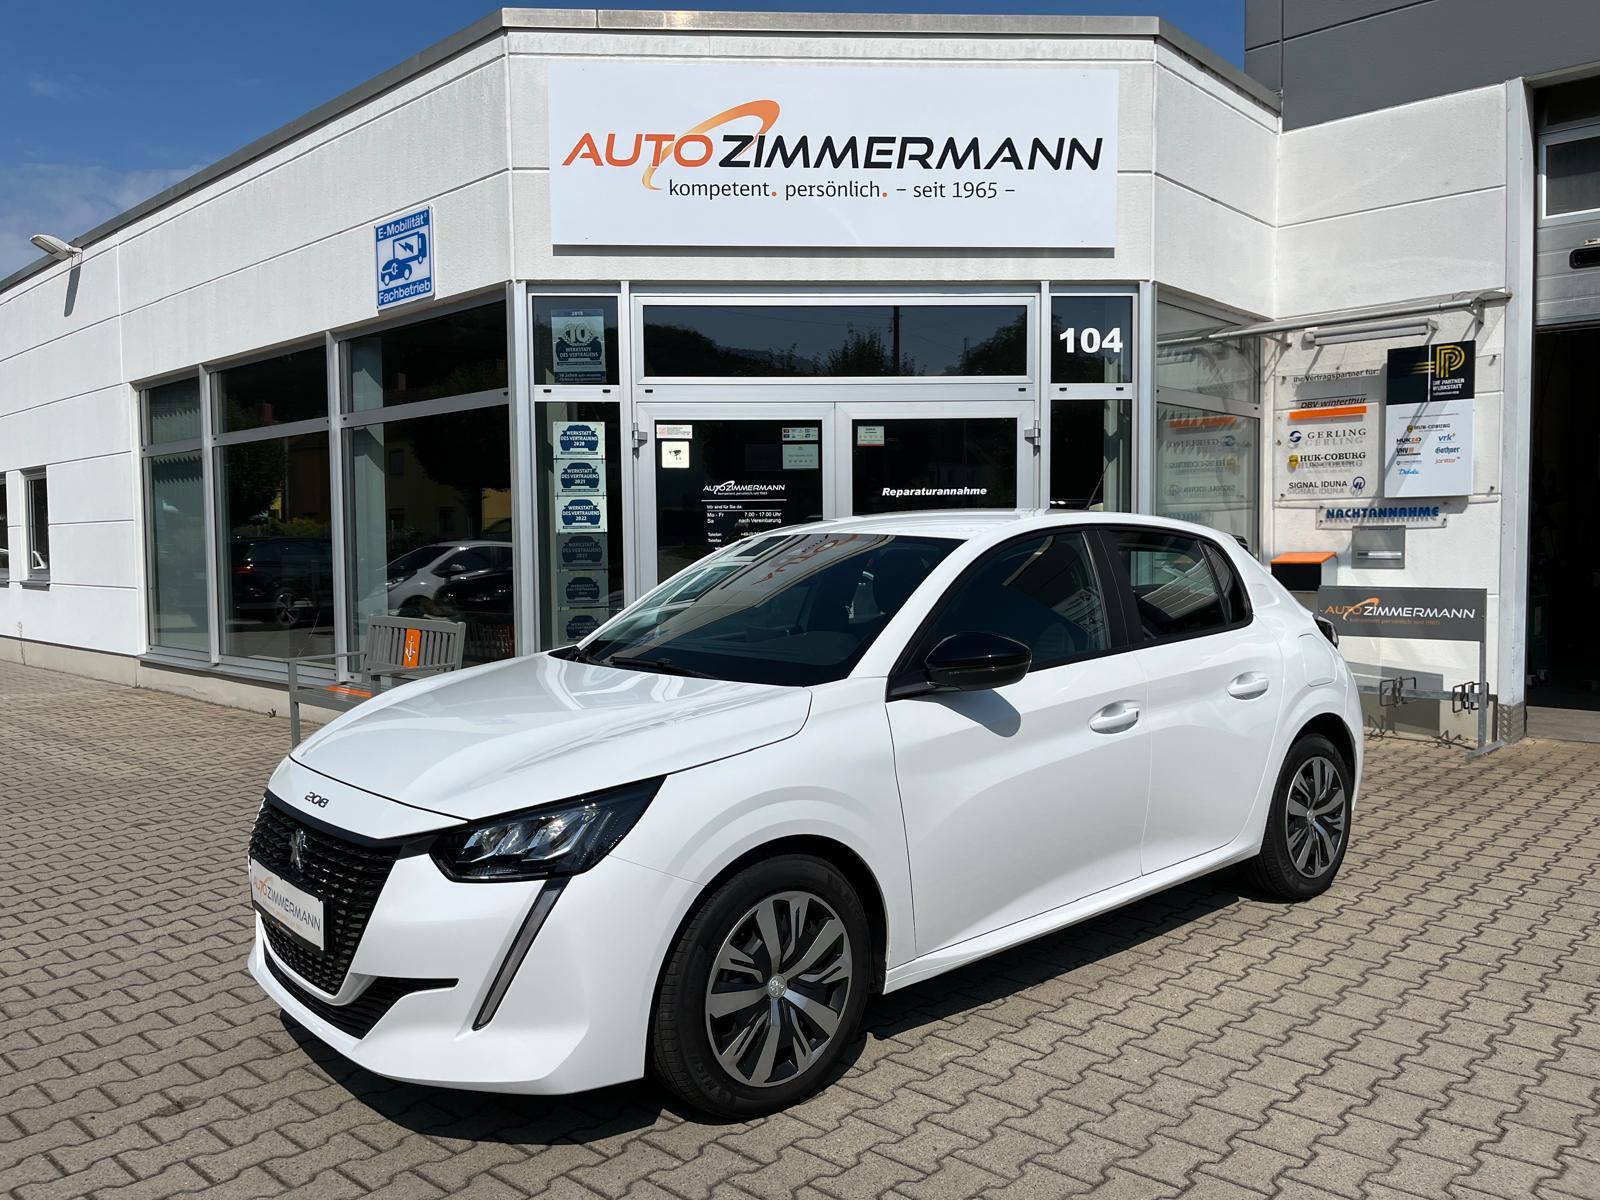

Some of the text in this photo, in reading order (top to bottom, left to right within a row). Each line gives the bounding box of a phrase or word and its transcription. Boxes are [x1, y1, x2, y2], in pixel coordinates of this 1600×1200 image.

[669, 179, 777, 200] kompetent.
[785, 180, 888, 200] persönlich.
[913, 181, 946, 198] seit
[952, 181, 998, 199] 1965
[379, 280, 431, 304] Fachbetrieb
[1059, 327, 1124, 354] 104
[1307, 428, 1367, 440] GERLING
[1438, 433, 1453, 441] vrk
[1299, 451, 1367, 463] HUK-COBURG
[1288, 480, 1348, 490] SIGNAL IDUNA
[882, 486, 988, 498] Reparaturannahme
[1325, 506, 1440, 520] NACHTANNAHME
[304, 791, 330, 809] 208
